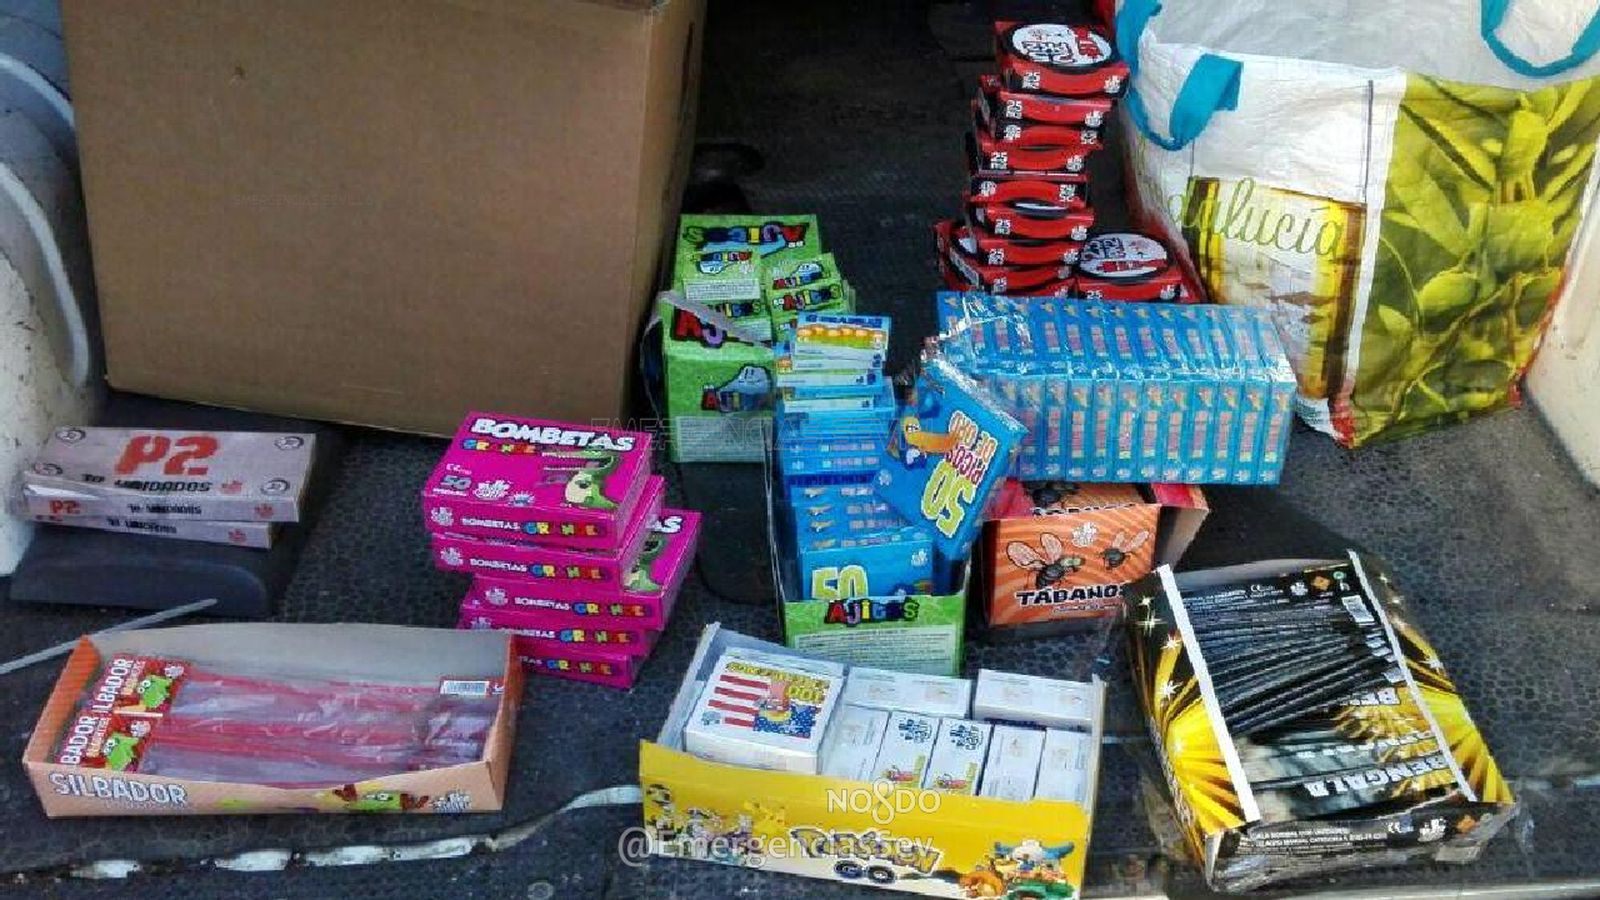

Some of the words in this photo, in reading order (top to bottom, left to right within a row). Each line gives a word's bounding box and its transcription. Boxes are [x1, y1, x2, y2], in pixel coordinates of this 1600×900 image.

[1007, 100, 1022, 110] 25
[993, 152, 1007, 162] 25
[996, 219, 1010, 228] 25
[471, 418, 635, 451] BOMBETAS
[113, 435, 220, 476] P2
[922, 457, 978, 539] 50
[461, 517, 520, 530] BOMBETAS
[469, 557, 528, 572] BOMBETAS
[513, 596, 571, 611] BOMBETAS
[93, 658, 133, 713] ILBADOR
[60, 715, 100, 765] BADOR
[50, 772, 188, 804] SILBADOR
[1303, 753, 1448, 798] BENGALA
